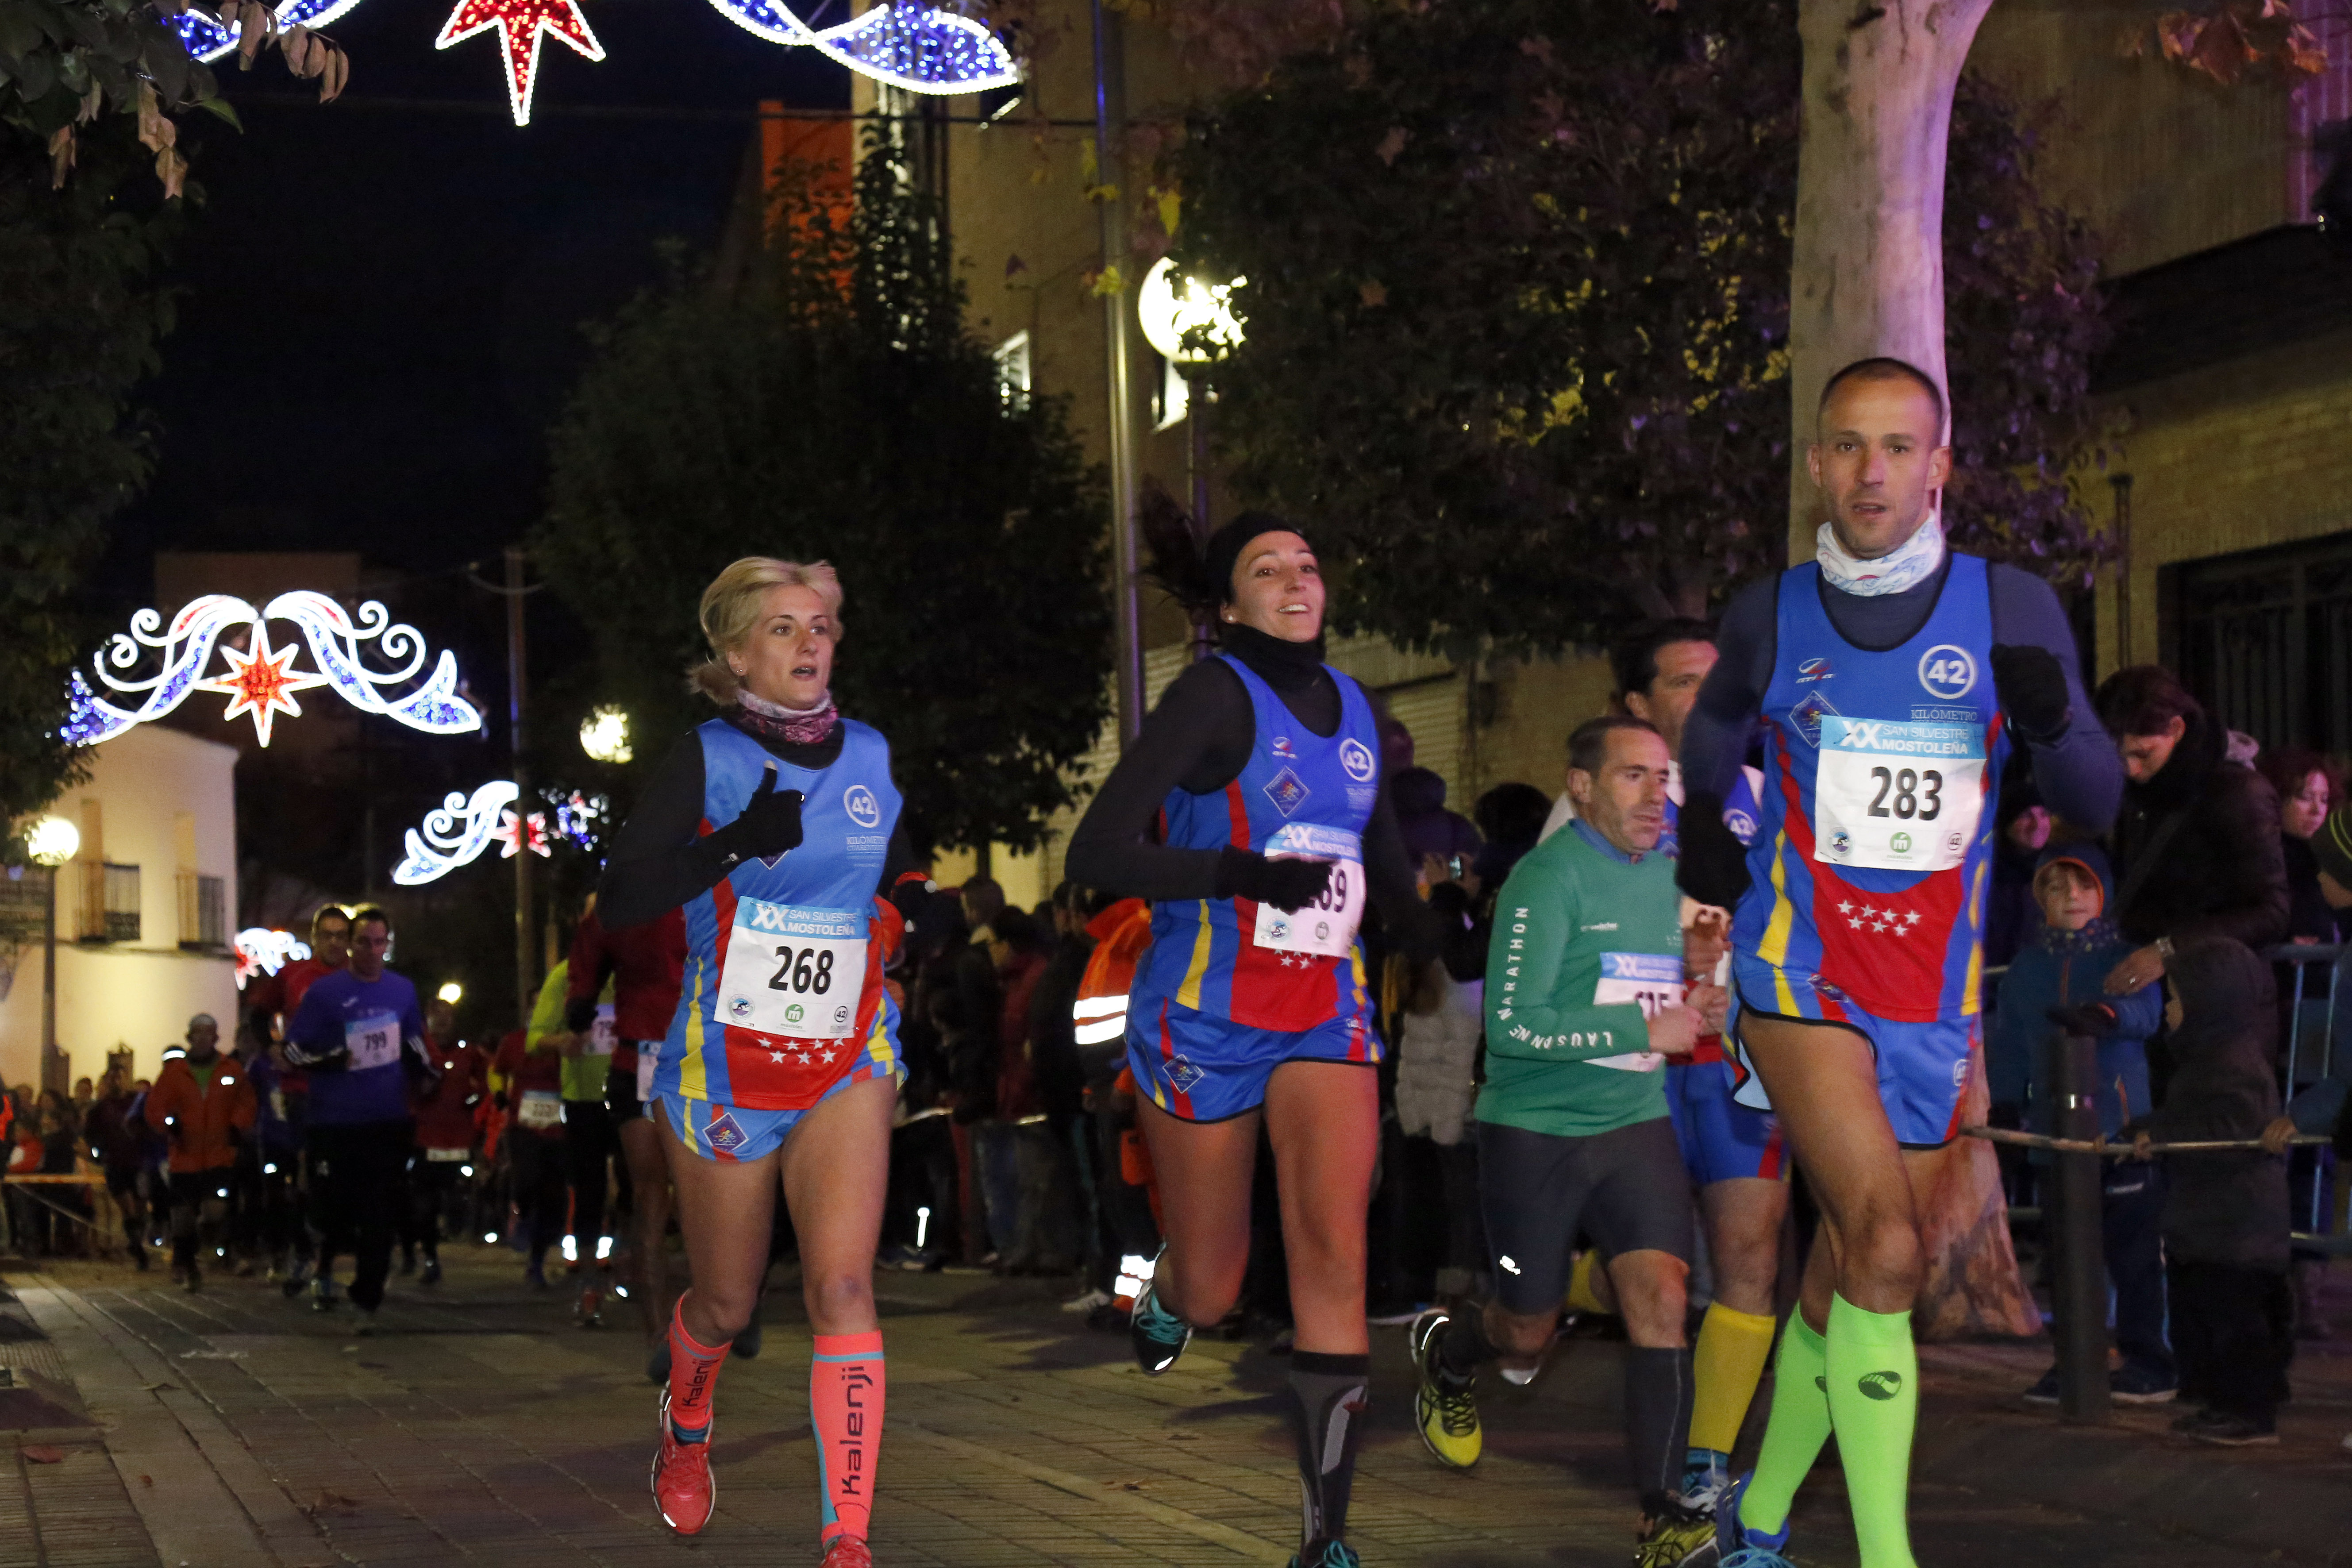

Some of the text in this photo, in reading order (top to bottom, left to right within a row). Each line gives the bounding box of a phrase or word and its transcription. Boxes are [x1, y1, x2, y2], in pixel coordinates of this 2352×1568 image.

[1928, 660, 1966, 684] 42
[1840, 720, 1882, 749] XX
[1883, 725, 1969, 739] SAN SILVESTRE
[1882, 739, 1968, 754] MOSTOLEÑA
[1867, 766, 1943, 821] 283
[852, 797, 875, 815] 42
[751, 903, 790, 932] XX
[789, 910, 857, 922] SAN SILVESTRE
[788, 922, 856, 936] MOSTOLEÑA
[768, 946, 834, 995] 268
[364, 1031, 387, 1052] 799
[681, 1358, 721, 1407] kalenji
[840, 1366, 873, 1495] kalenji
